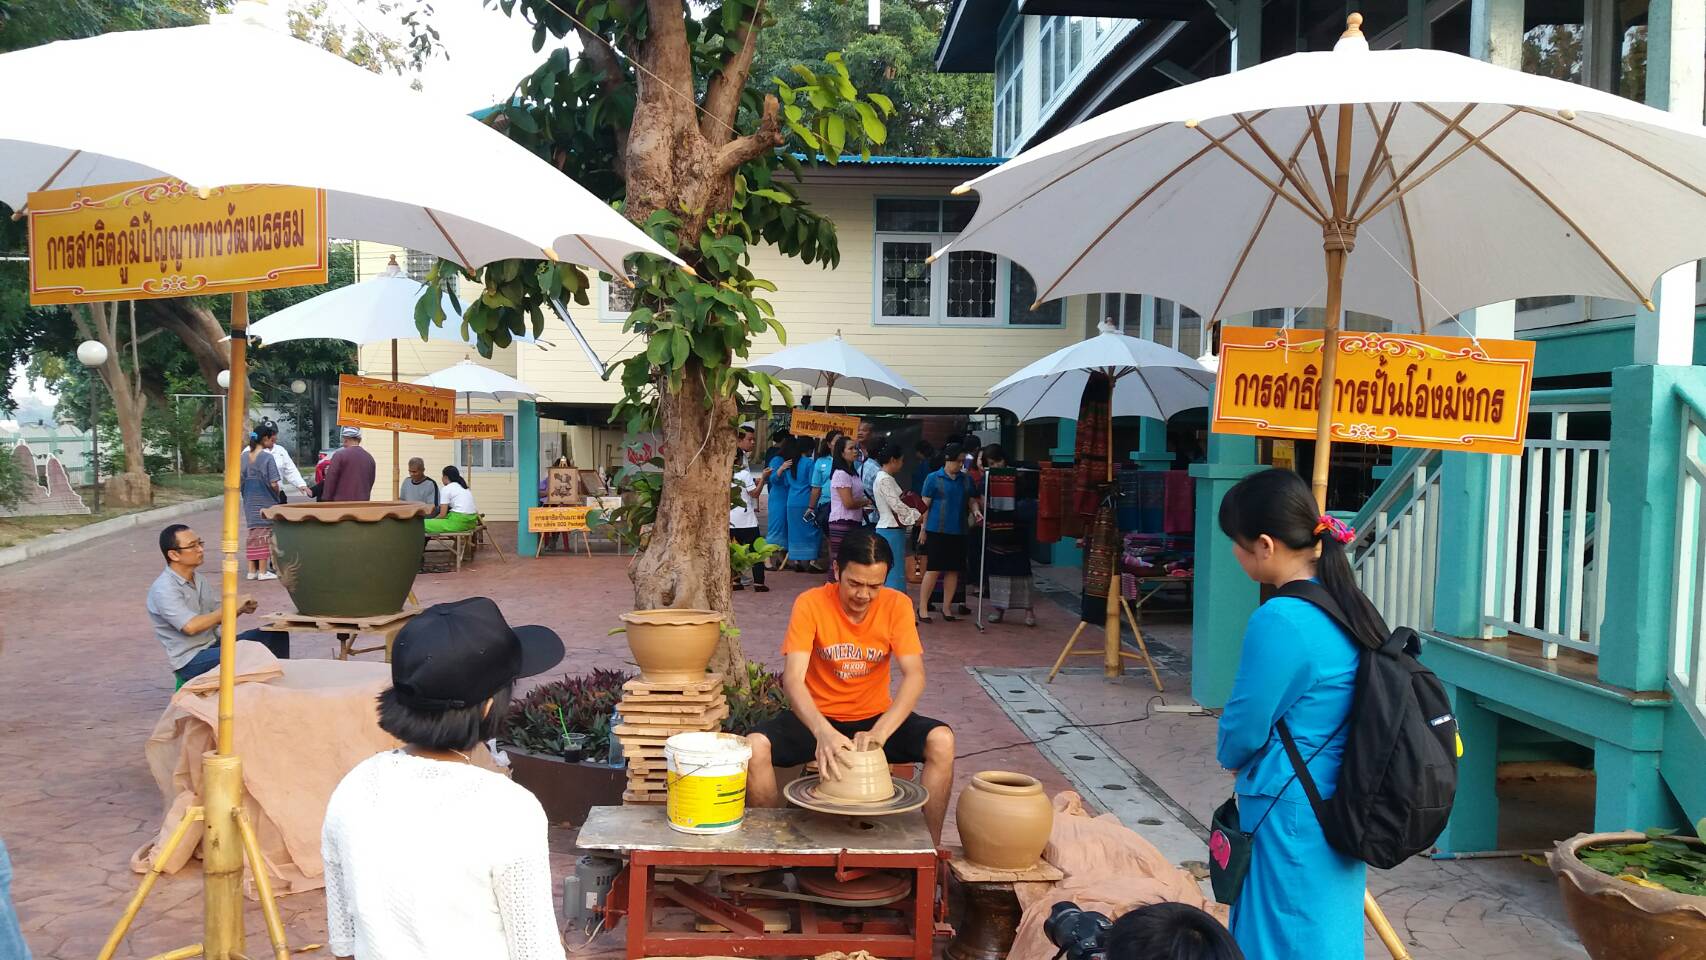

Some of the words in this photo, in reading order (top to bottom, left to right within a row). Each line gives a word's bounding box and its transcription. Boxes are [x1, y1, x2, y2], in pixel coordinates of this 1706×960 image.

[46, 202, 305, 285] การสาธิตภูมิปัญญาทางวัฒนธรรม
[454, 421, 498, 433] าธิตการจักสาน
